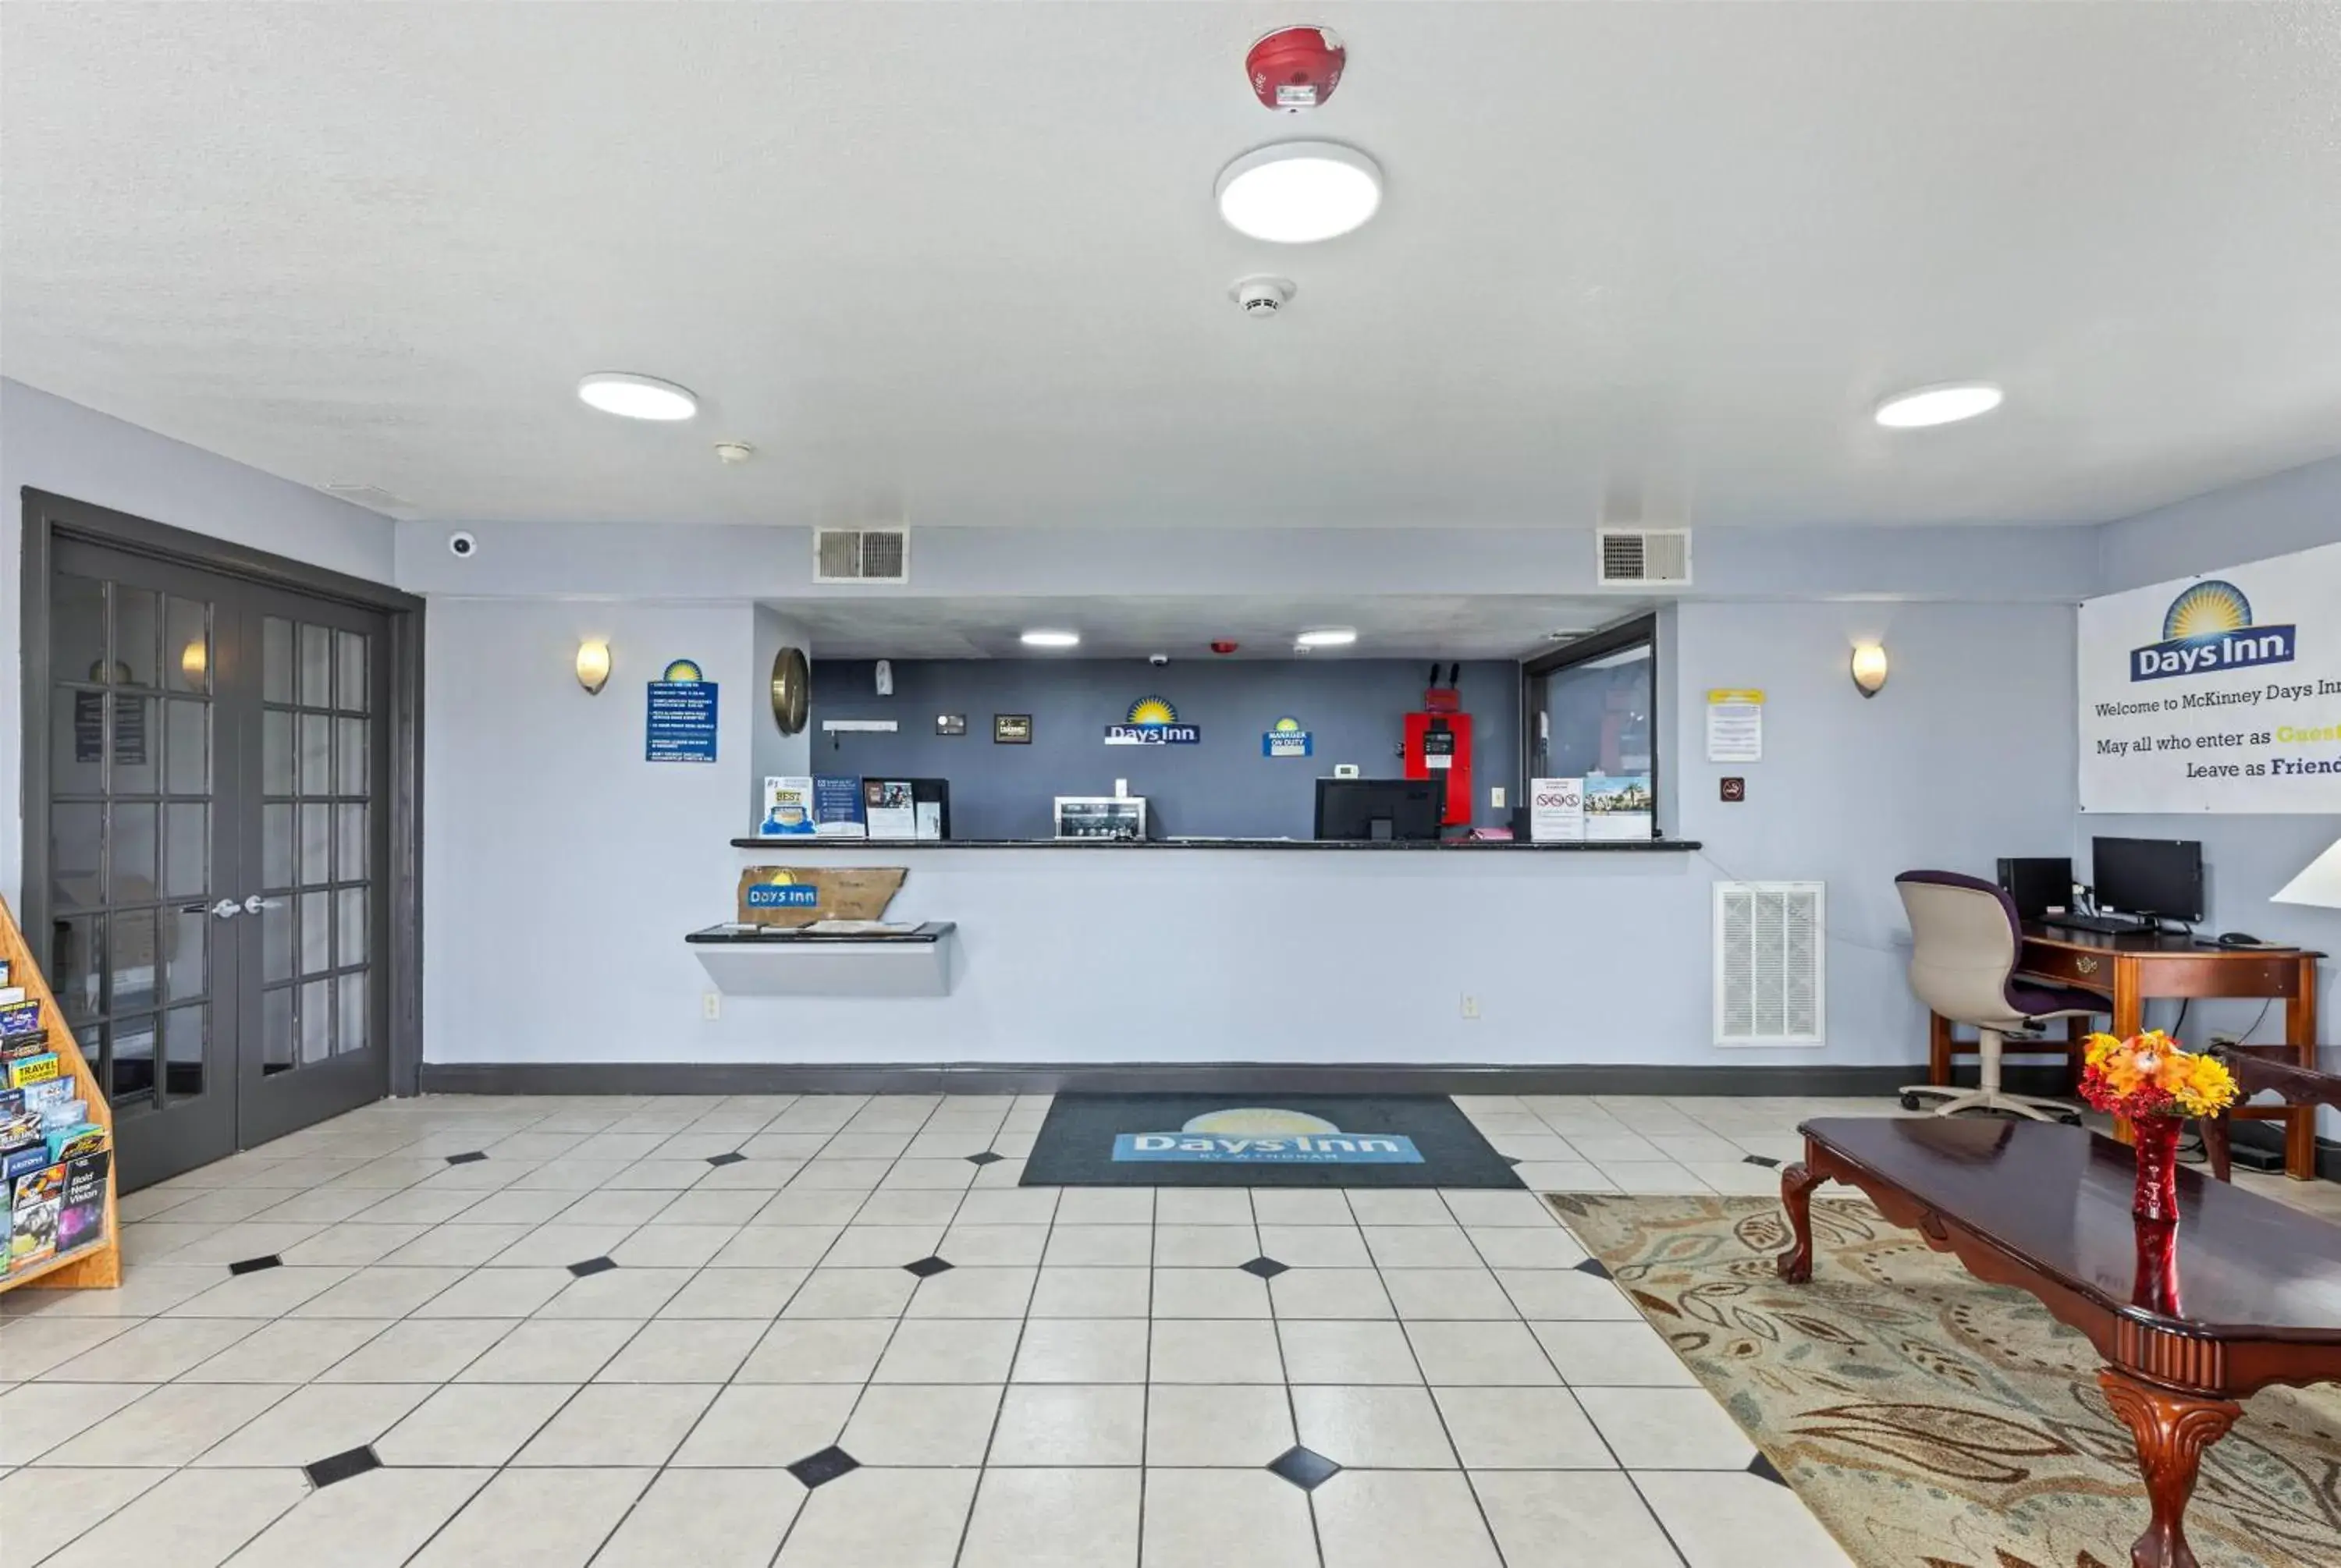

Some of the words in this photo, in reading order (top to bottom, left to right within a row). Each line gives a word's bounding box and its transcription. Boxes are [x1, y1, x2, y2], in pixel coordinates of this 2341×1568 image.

[2139, 643, 2217, 676] Days
[2222, 635, 2285, 664] Inn
[2094, 701, 2159, 717] Welcome
[2164, 698, 2178, 711] to
[2182, 690, 2261, 709] McKinney
[2266, 683, 2312, 701] Days
[1110, 726, 1159, 743] Days
[1162, 726, 1195, 741] Inn
[2097, 740, 2128, 756] May
[2133, 736, 2151, 751] all
[2157, 734, 2191, 750] who
[2197, 732, 2243, 747] enter
[2250, 732, 2271, 744] as
[2186, 762, 2240, 778] Leave
[2245, 764, 2265, 776] as
[776, 792, 801, 801] BEST
[751, 890, 786, 903] Days
[19, 1061, 56, 1077] TRAVEL
[1135, 1135, 1284, 1154] Days
[1298, 1135, 1399, 1152] Inn
